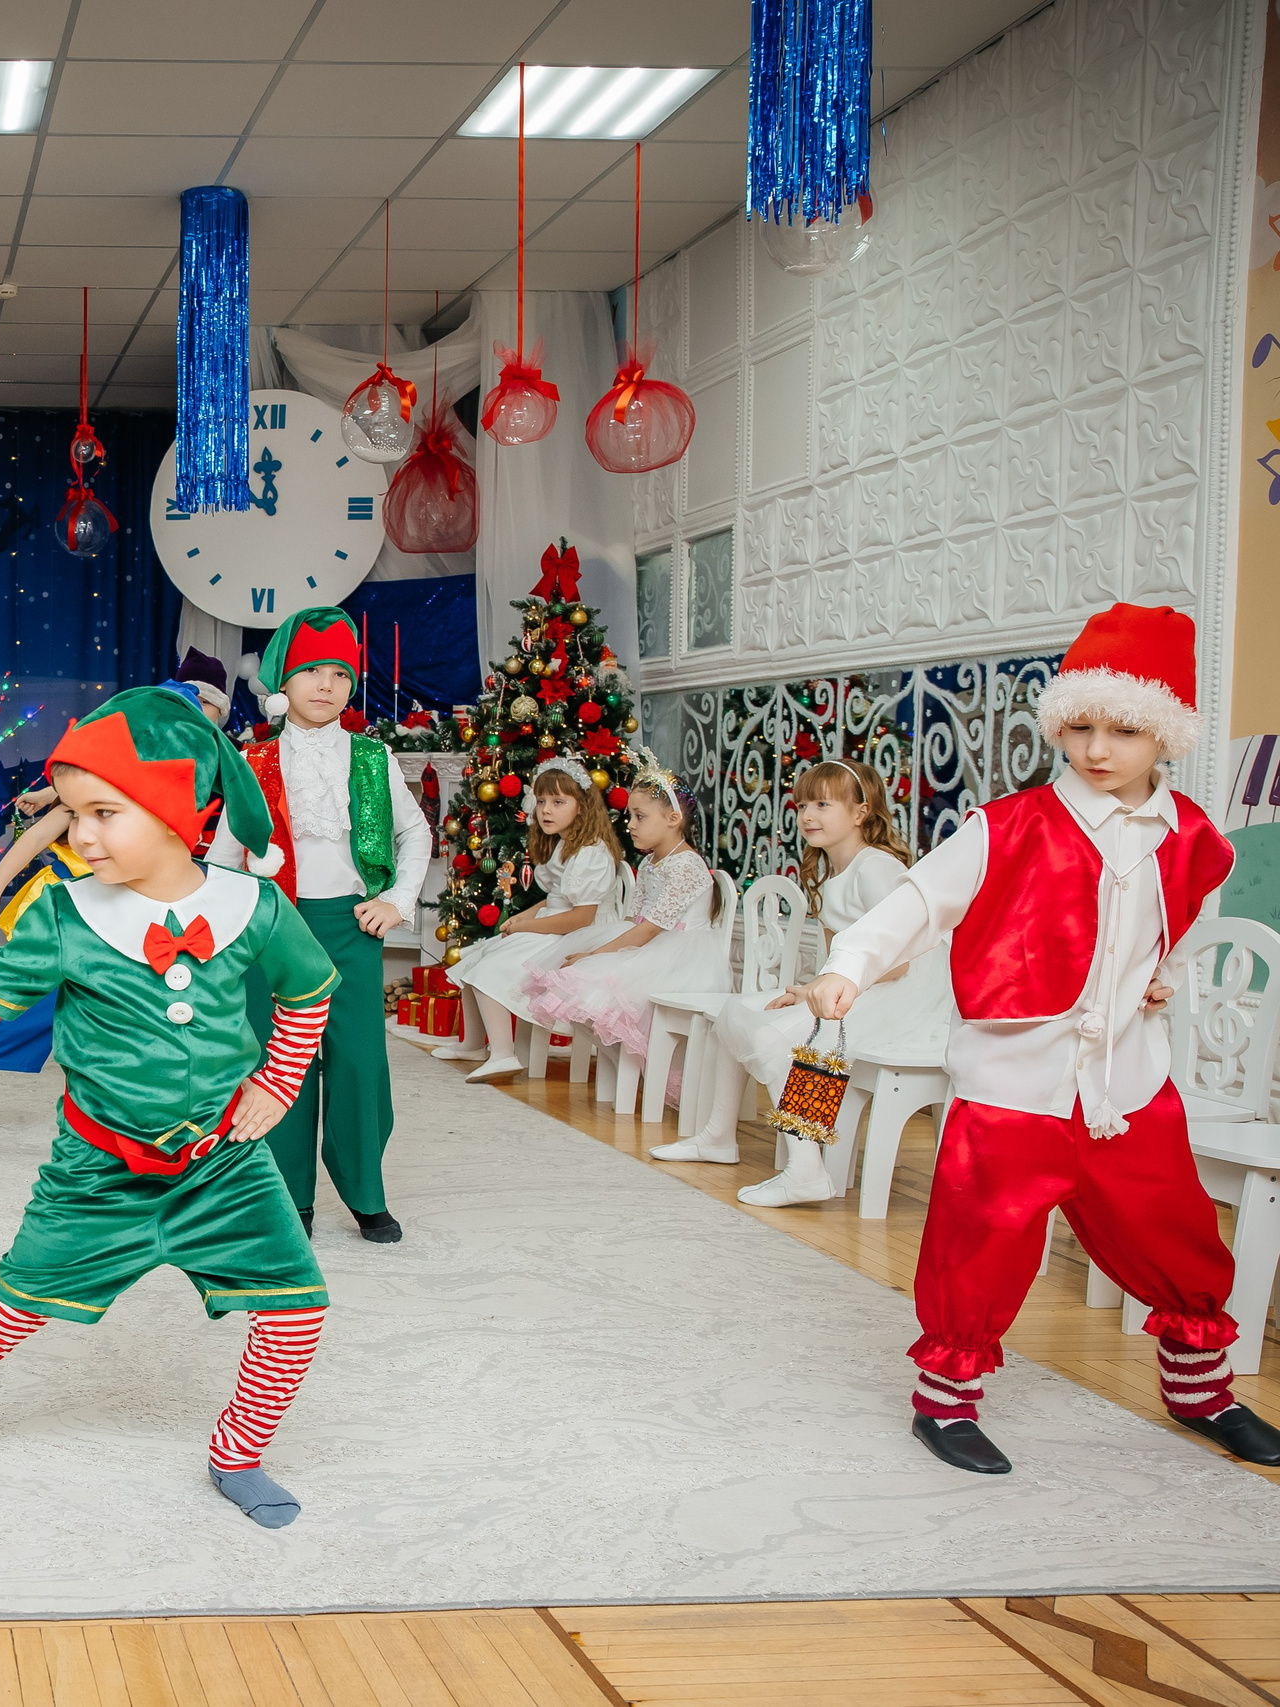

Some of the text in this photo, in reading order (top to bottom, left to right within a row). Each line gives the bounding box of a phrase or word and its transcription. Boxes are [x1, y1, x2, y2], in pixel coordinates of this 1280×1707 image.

[253, 404, 286, 430] XII
[348, 497, 373, 520] III
[251, 588, 275, 613] VI
